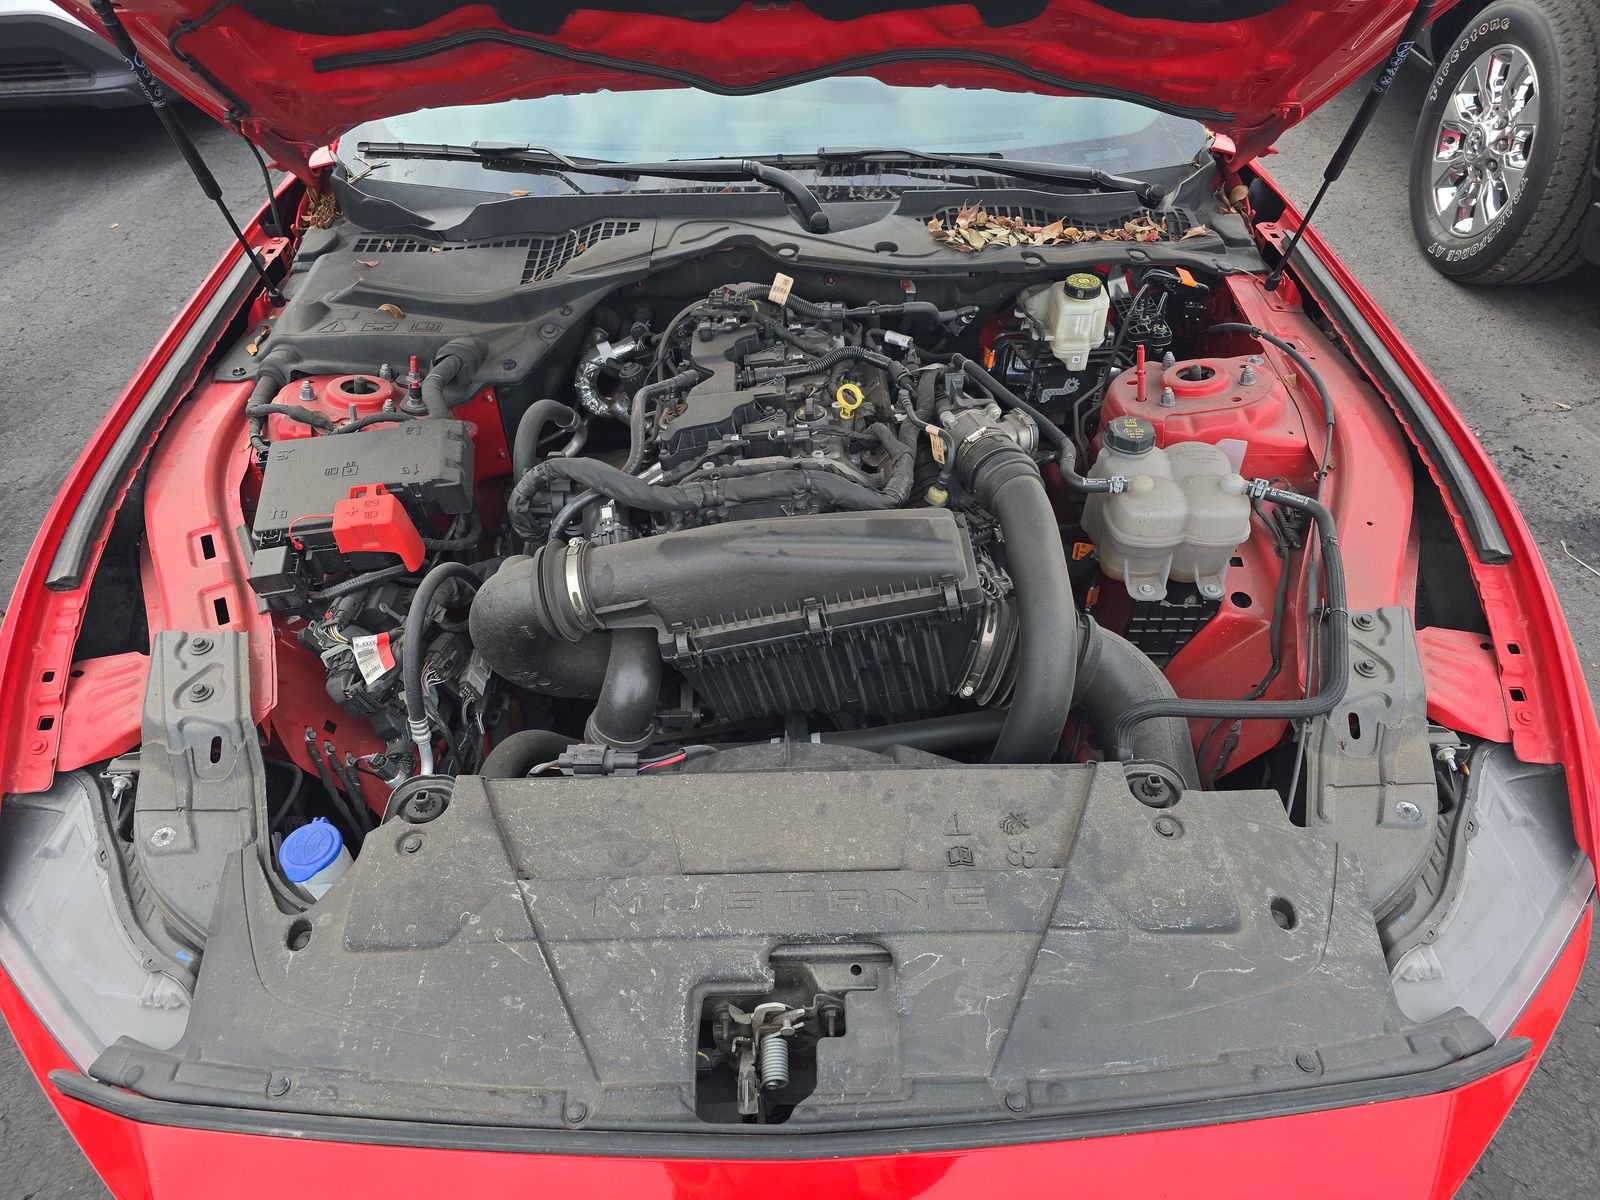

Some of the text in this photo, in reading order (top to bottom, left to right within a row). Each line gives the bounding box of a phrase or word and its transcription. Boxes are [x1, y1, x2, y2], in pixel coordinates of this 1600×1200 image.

[1429, 17, 1511, 101] Firestone
[1427, 177, 1529, 262] TRANSFORCE AT
[592, 885, 989, 918] MUSTANG
